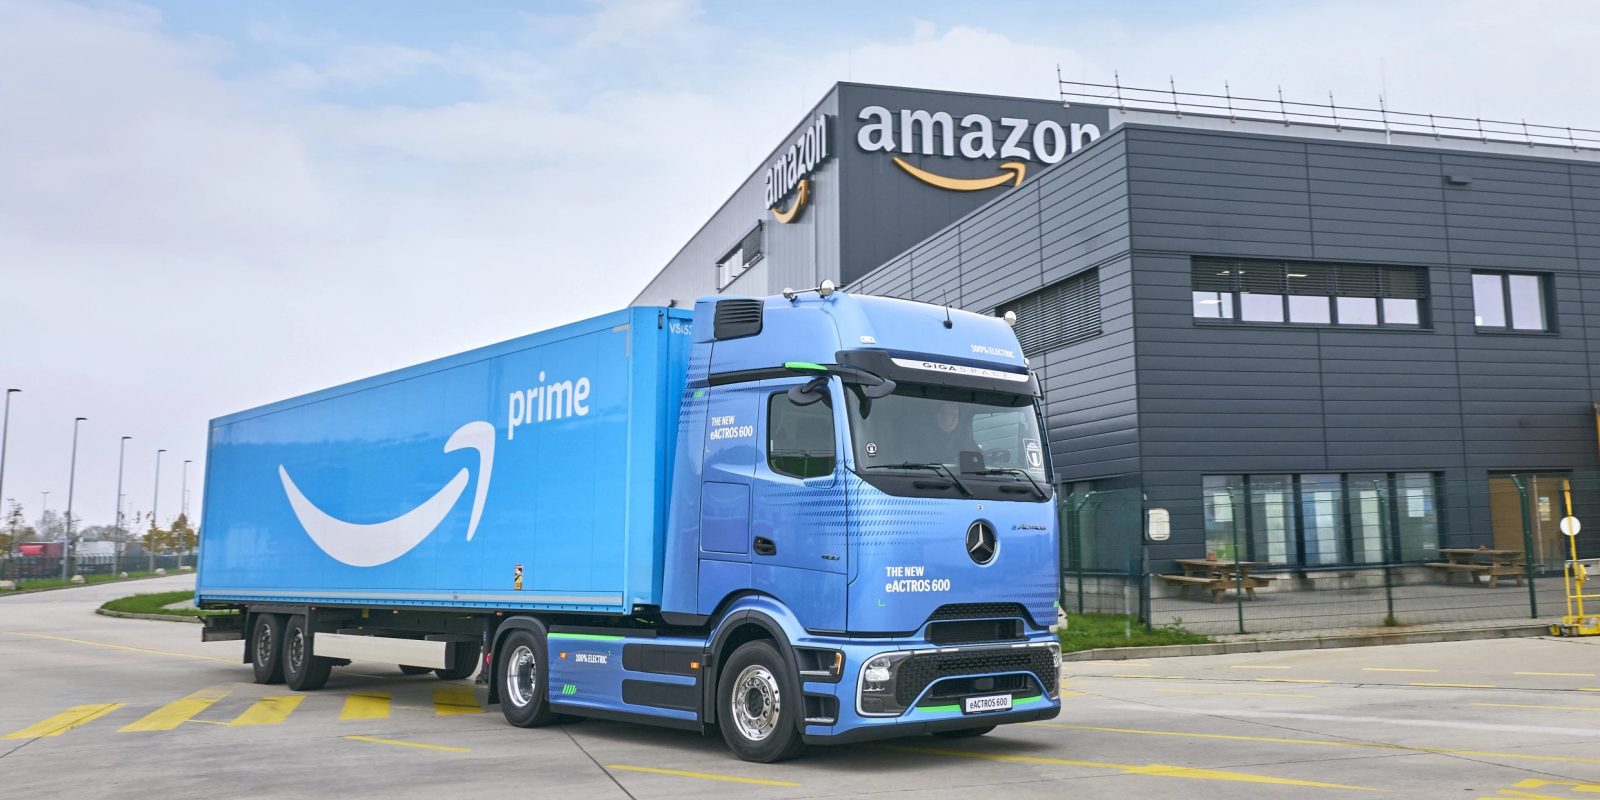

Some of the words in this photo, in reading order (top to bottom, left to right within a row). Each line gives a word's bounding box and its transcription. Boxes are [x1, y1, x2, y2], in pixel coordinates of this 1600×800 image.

[765, 113, 828, 209] amazon
[970, 344, 988, 354] 100%
[989, 346, 1016, 359] ELECTRIC
[508, 370, 590, 441] prime
[711, 416, 721, 426] THE
[722, 415, 735, 425] NEW
[710, 427, 738, 440] eACTROS
[739, 425, 753, 437] 600
[885, 566, 903, 577] THE
[904, 566, 924, 577] NEW
[885, 579, 930, 592] eACTROS
[931, 578, 950, 592] 600
[575, 653, 587, 662] 100%
[587, 654, 607, 664] ELECTRIC
[970, 698, 995, 709] eACTROS
[996, 697, 1008, 707] 600
